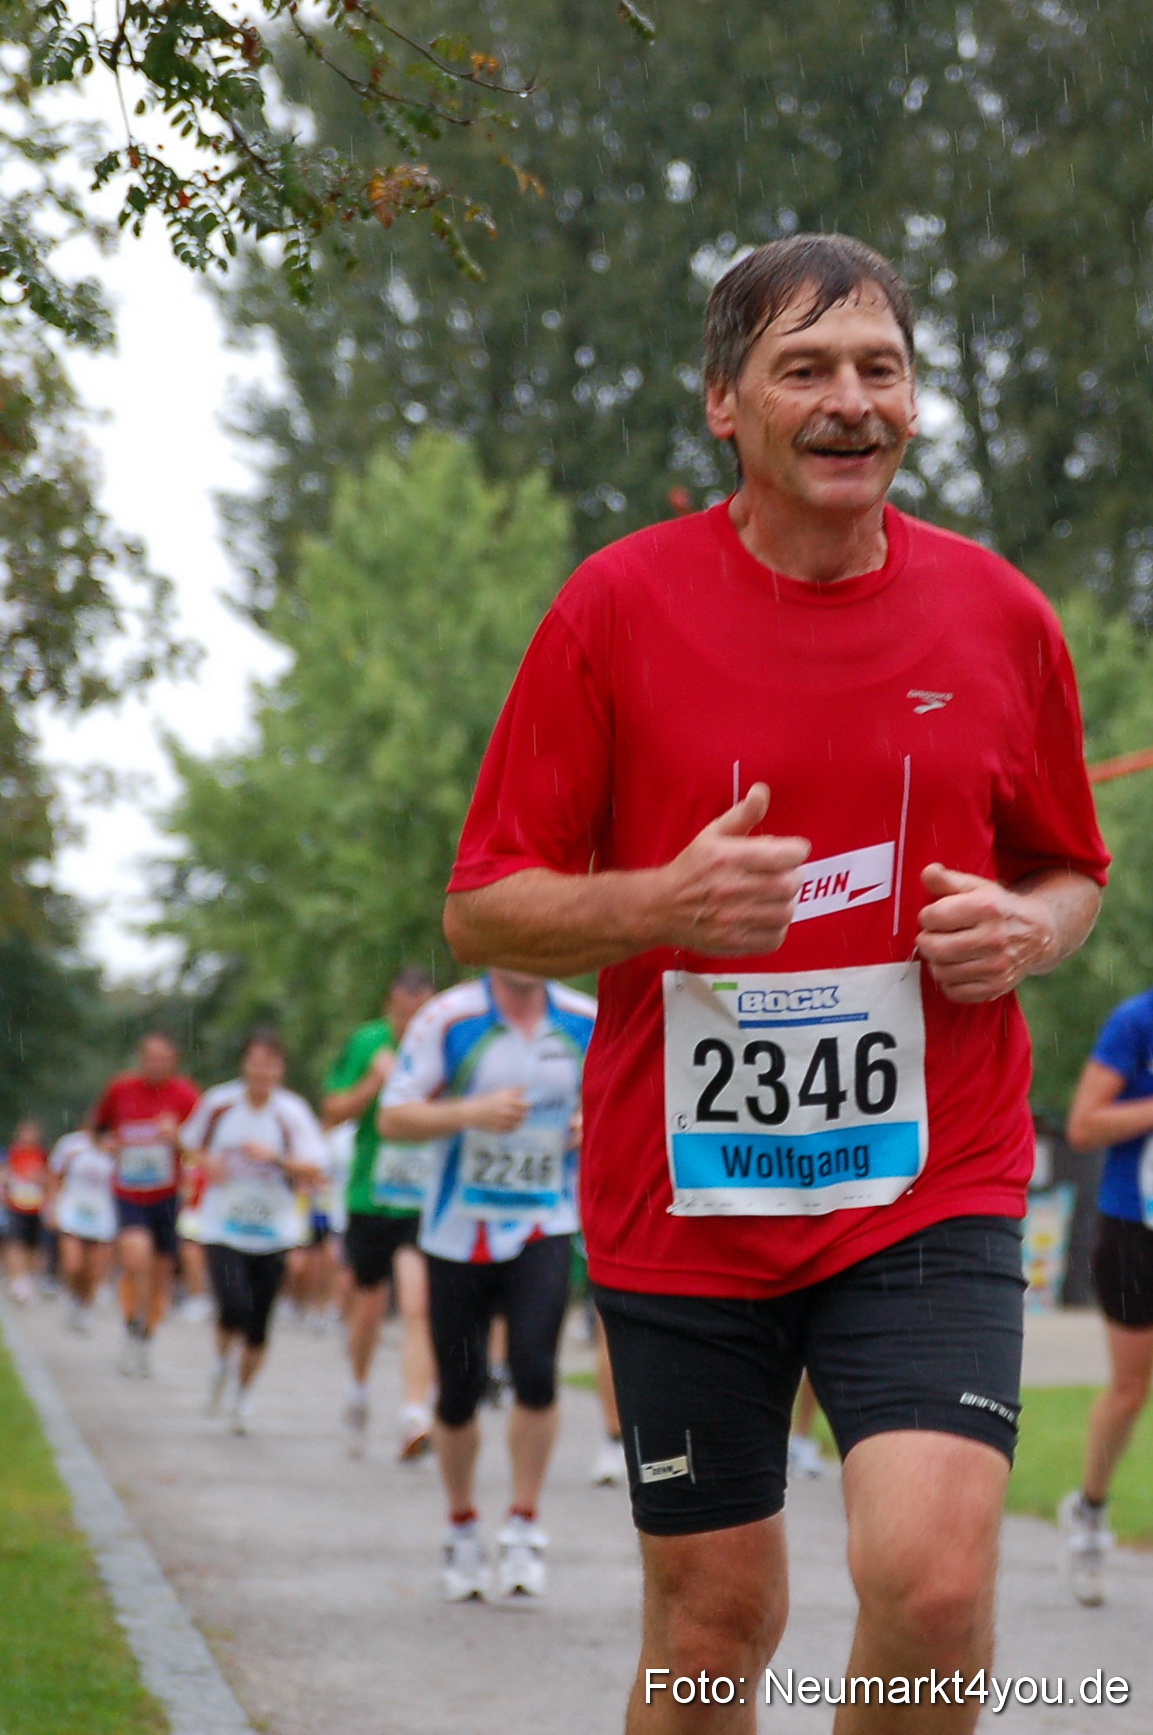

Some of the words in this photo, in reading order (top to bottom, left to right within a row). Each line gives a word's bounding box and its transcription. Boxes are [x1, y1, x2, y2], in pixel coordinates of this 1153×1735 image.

[797, 870, 851, 904] EHN
[738, 985, 839, 1013] BOCK
[692, 1031, 898, 1126] 2346
[721, 1144, 870, 1187] Wolfgang
